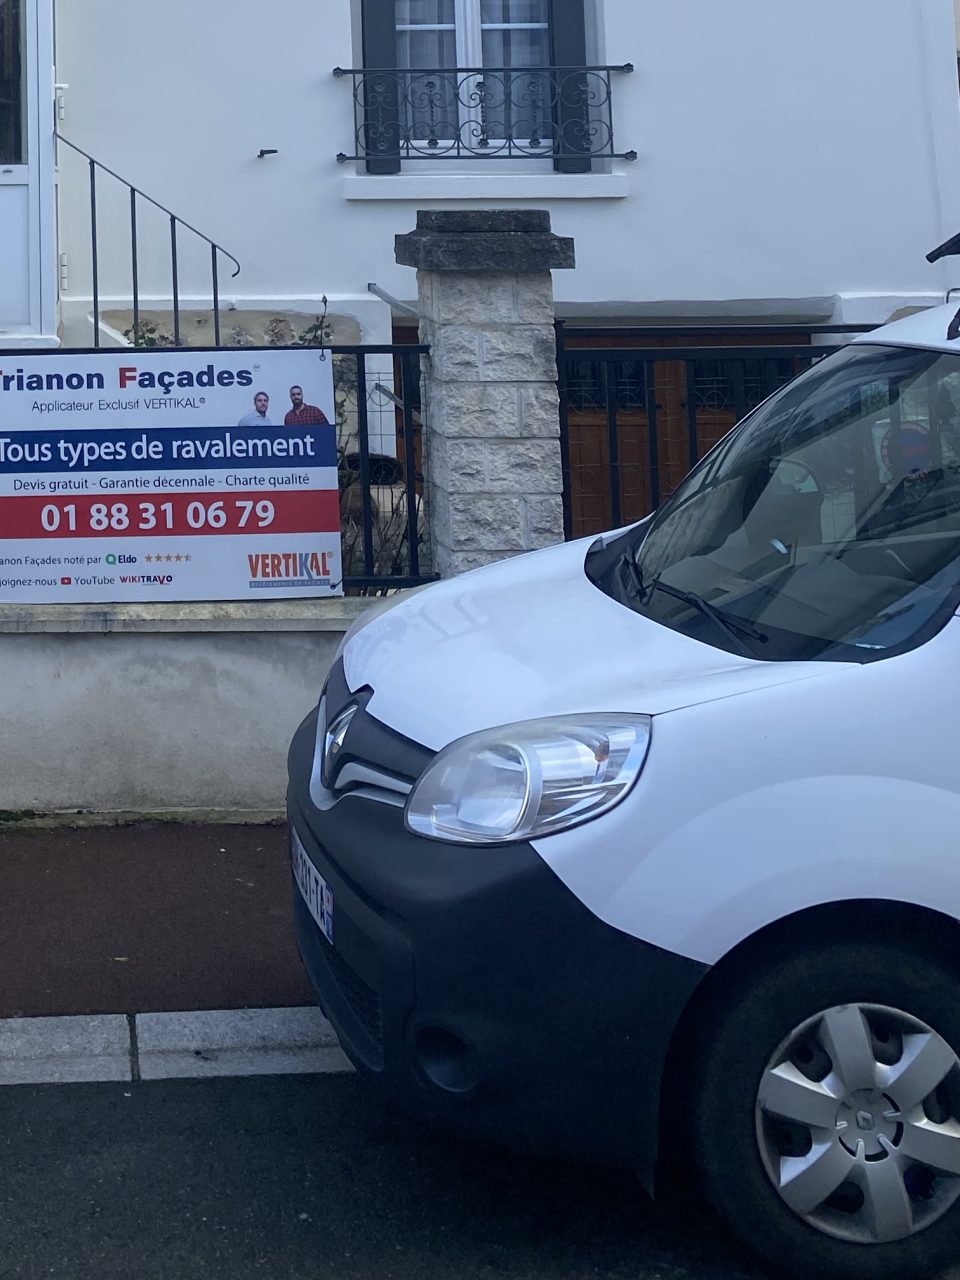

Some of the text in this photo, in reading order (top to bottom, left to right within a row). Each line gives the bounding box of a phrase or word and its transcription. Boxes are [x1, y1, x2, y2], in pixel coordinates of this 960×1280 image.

[119, 365, 253, 394] Façades
[32, 401, 94, 413] Applicateur
[98, 398, 139, 410] Exclusif
[57, 439, 127, 468] types
[131, 434, 164, 460] de
[172, 432, 315, 459] ravalement
[13, 479, 46, 490] Devis
[49, 478, 89, 493] gratuit
[99, 477, 150, 489] Garantie
[153, 475, 215, 488] décennale
[225, 475, 266, 486] Charte
[268, 473, 310, 487] qualité
[41, 500, 275, 531] 01 88 31 06 79
[24, 554, 62, 567] Façades
[64, 554, 85, 564] noté
[87, 557, 102, 567] par
[118, 554, 137, 564] Eldo
[74, 575, 115, 586] YouTube
